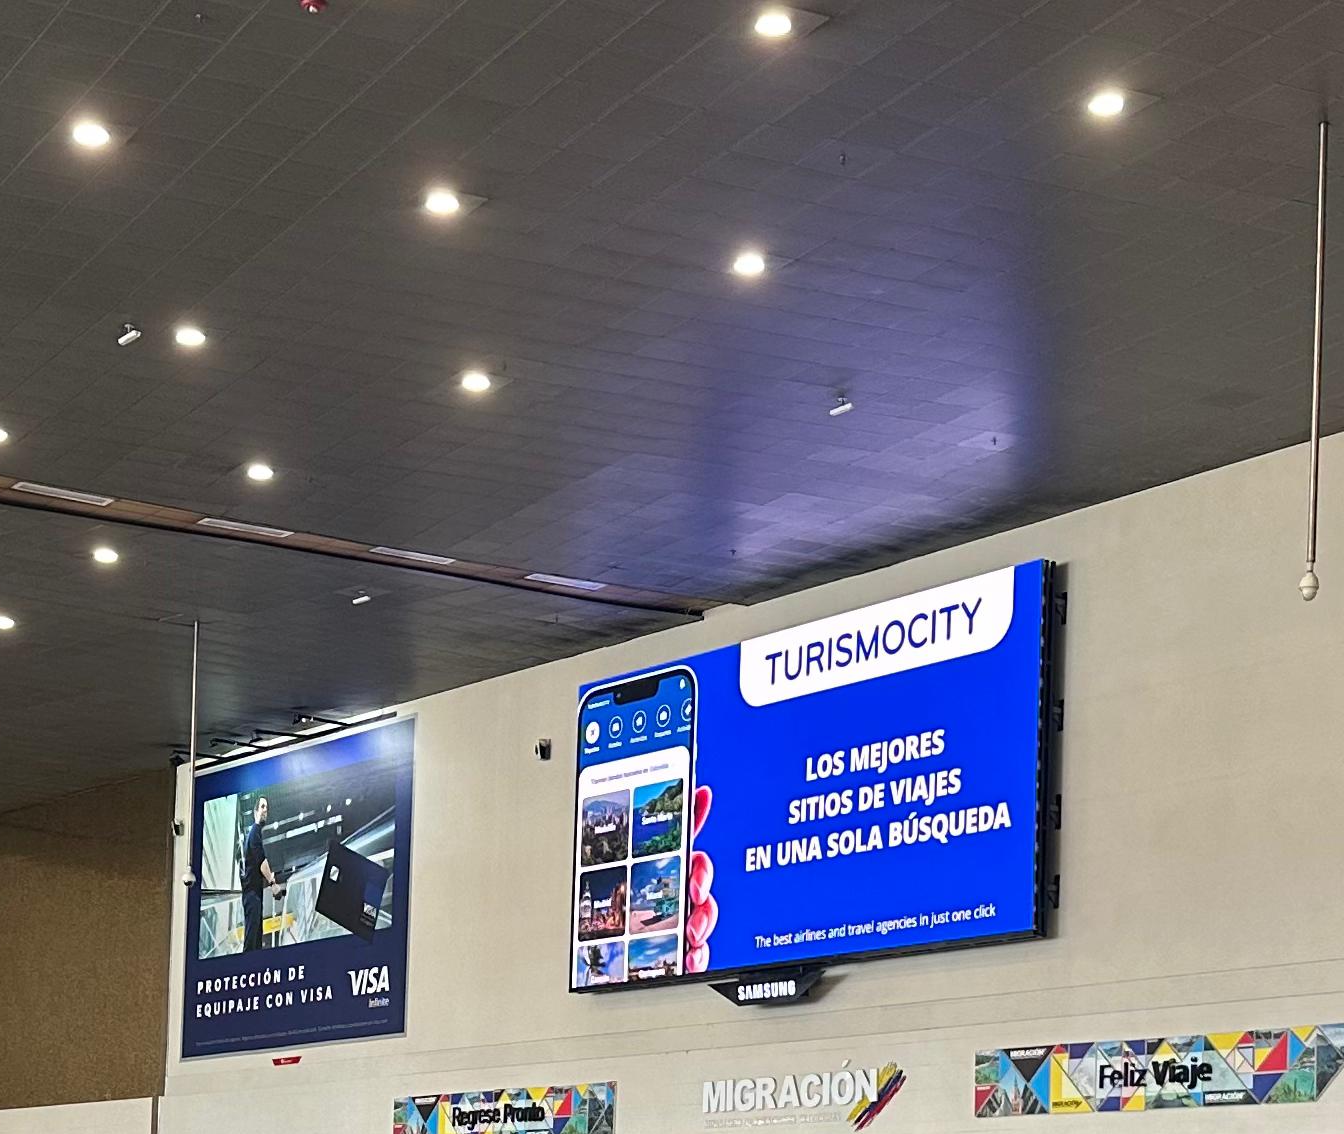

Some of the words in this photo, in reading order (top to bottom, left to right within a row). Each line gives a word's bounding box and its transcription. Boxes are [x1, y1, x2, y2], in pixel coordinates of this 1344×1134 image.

[765, 597, 982, 685] TURISMOCITY
[806, 751, 845, 781] LOS
[850, 729, 945, 773] MEJORES
[788, 790, 853, 824] SITIOS
[858, 784, 885, 812] DE
[890, 768, 962, 806] VIAJES
[745, 845, 771, 872] EN
[777, 835, 822, 866] UNA
[826, 825, 883, 858] SOLA
[888, 802, 1012, 847] BÚSQUEDA
[755, 936, 771, 949] The
[773, 933, 792, 947] best
[794, 928, 826, 943] airlines
[828, 924, 846, 939] and
[847, 920, 874, 936] travel
[876, 916, 917, 935] agencies
[919, 914, 928, 927] in
[929, 912, 950, 930] just
[951, 909, 972, 923] one
[973, 902, 996, 920] click
[197, 967, 281, 995] PROTECCIÓN
[288, 965, 305, 981] DE
[347, 965, 390, 996] VISA
[737, 980, 796, 1001] SAMSUNG
[196, 996, 259, 1018] EQUIPAJE
[266, 991, 293, 1009] CON
[301, 985, 333, 1003] VISA
[368, 997, 390, 1009] Infinite
[702, 1058, 879, 1113] MIGRACIÓN
[1099, 1062, 1147, 1089] Feliz
[1152, 1056, 1213, 1090] Viaje
[452, 1107, 501, 1130] Regrese
[503, 1103, 545, 1124] Pronto
